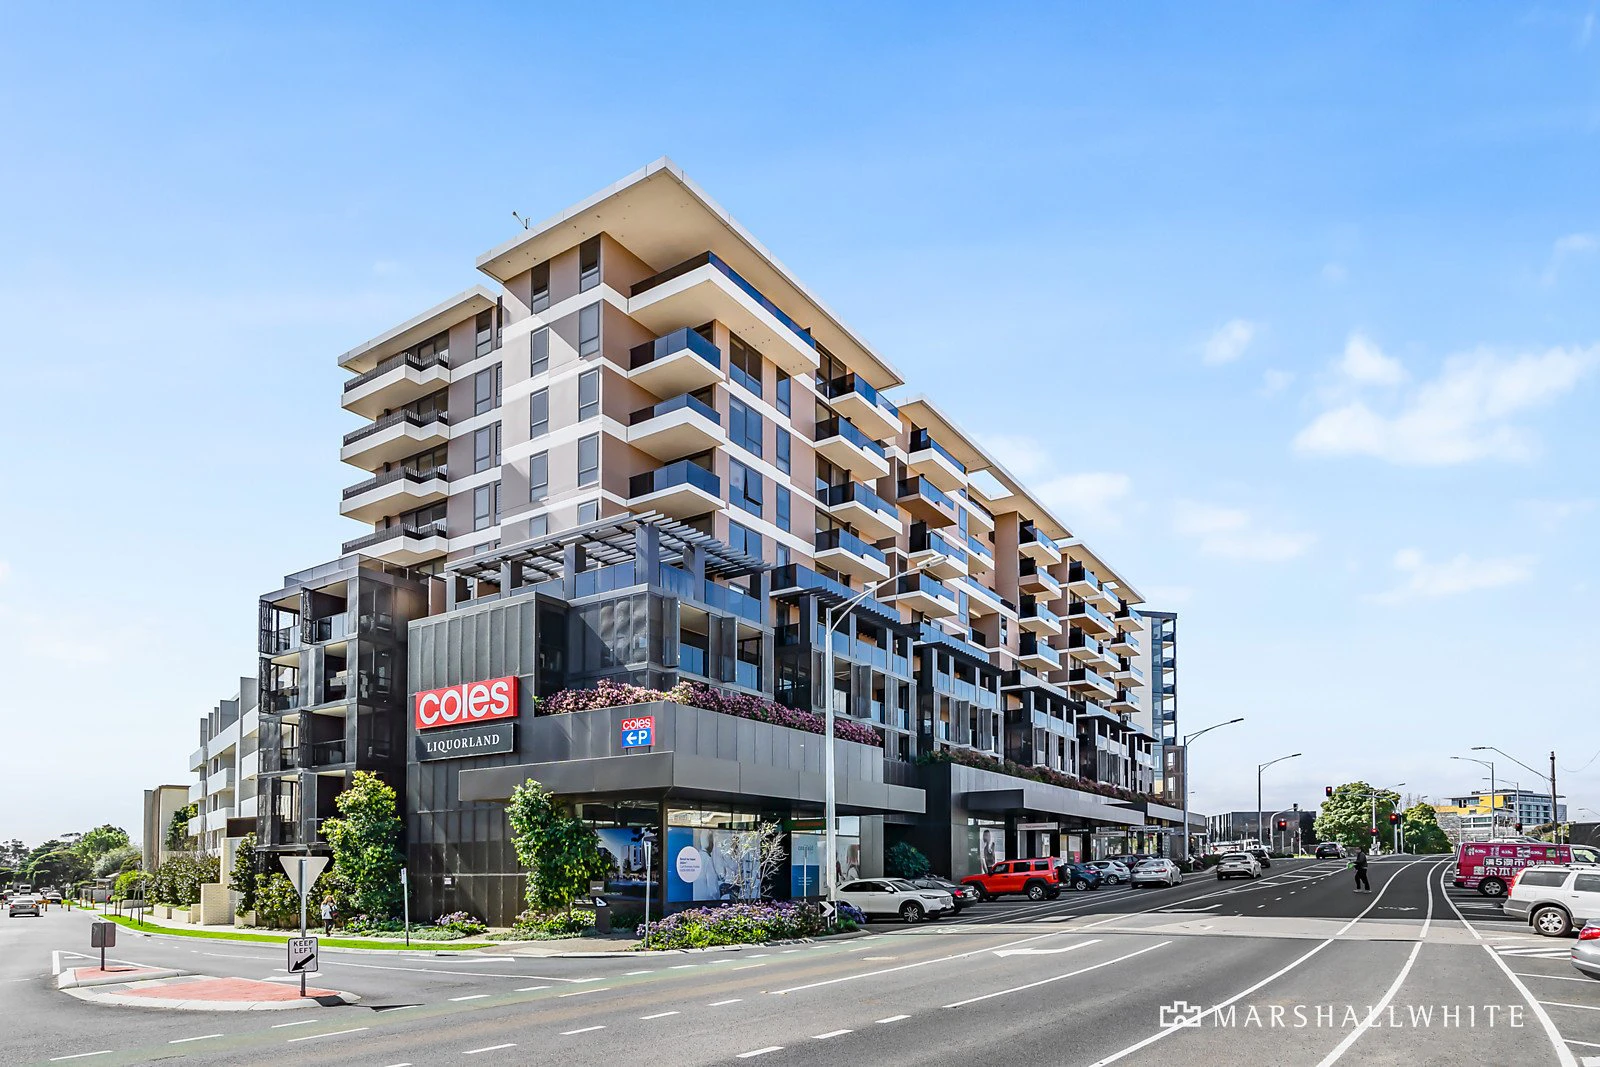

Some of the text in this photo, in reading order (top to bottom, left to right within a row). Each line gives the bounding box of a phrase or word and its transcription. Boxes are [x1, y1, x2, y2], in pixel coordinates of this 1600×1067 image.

[419, 681, 510, 725] coles
[622, 718, 651, 730] coles
[426, 734, 500, 753] LIQUORLAND
[638, 730, 648, 745] P
